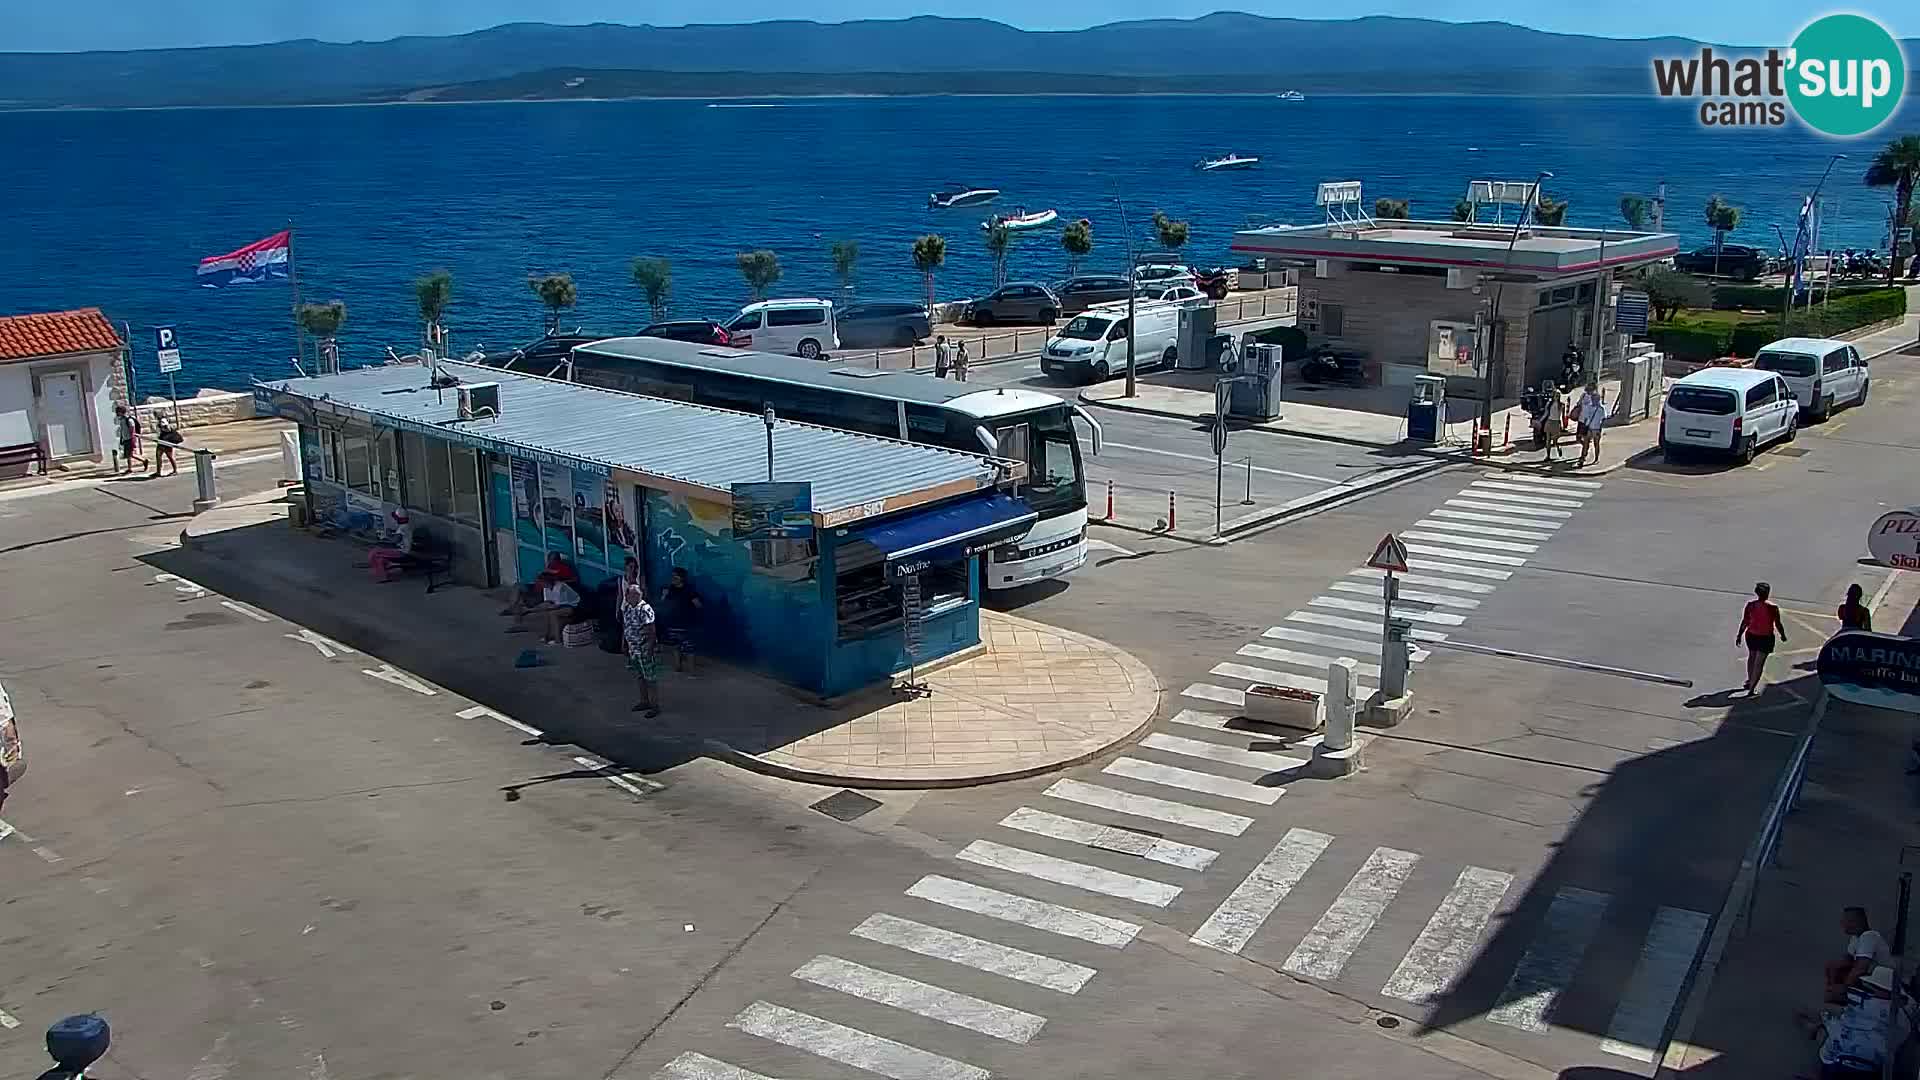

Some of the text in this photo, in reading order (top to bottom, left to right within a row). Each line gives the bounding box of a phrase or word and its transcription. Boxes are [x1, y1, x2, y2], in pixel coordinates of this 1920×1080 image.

[160, 329, 172, 347] P
[520, 450, 553, 464] STATION
[555, 456, 580, 471] TICKET
[581, 461, 608, 476] OFFICE
